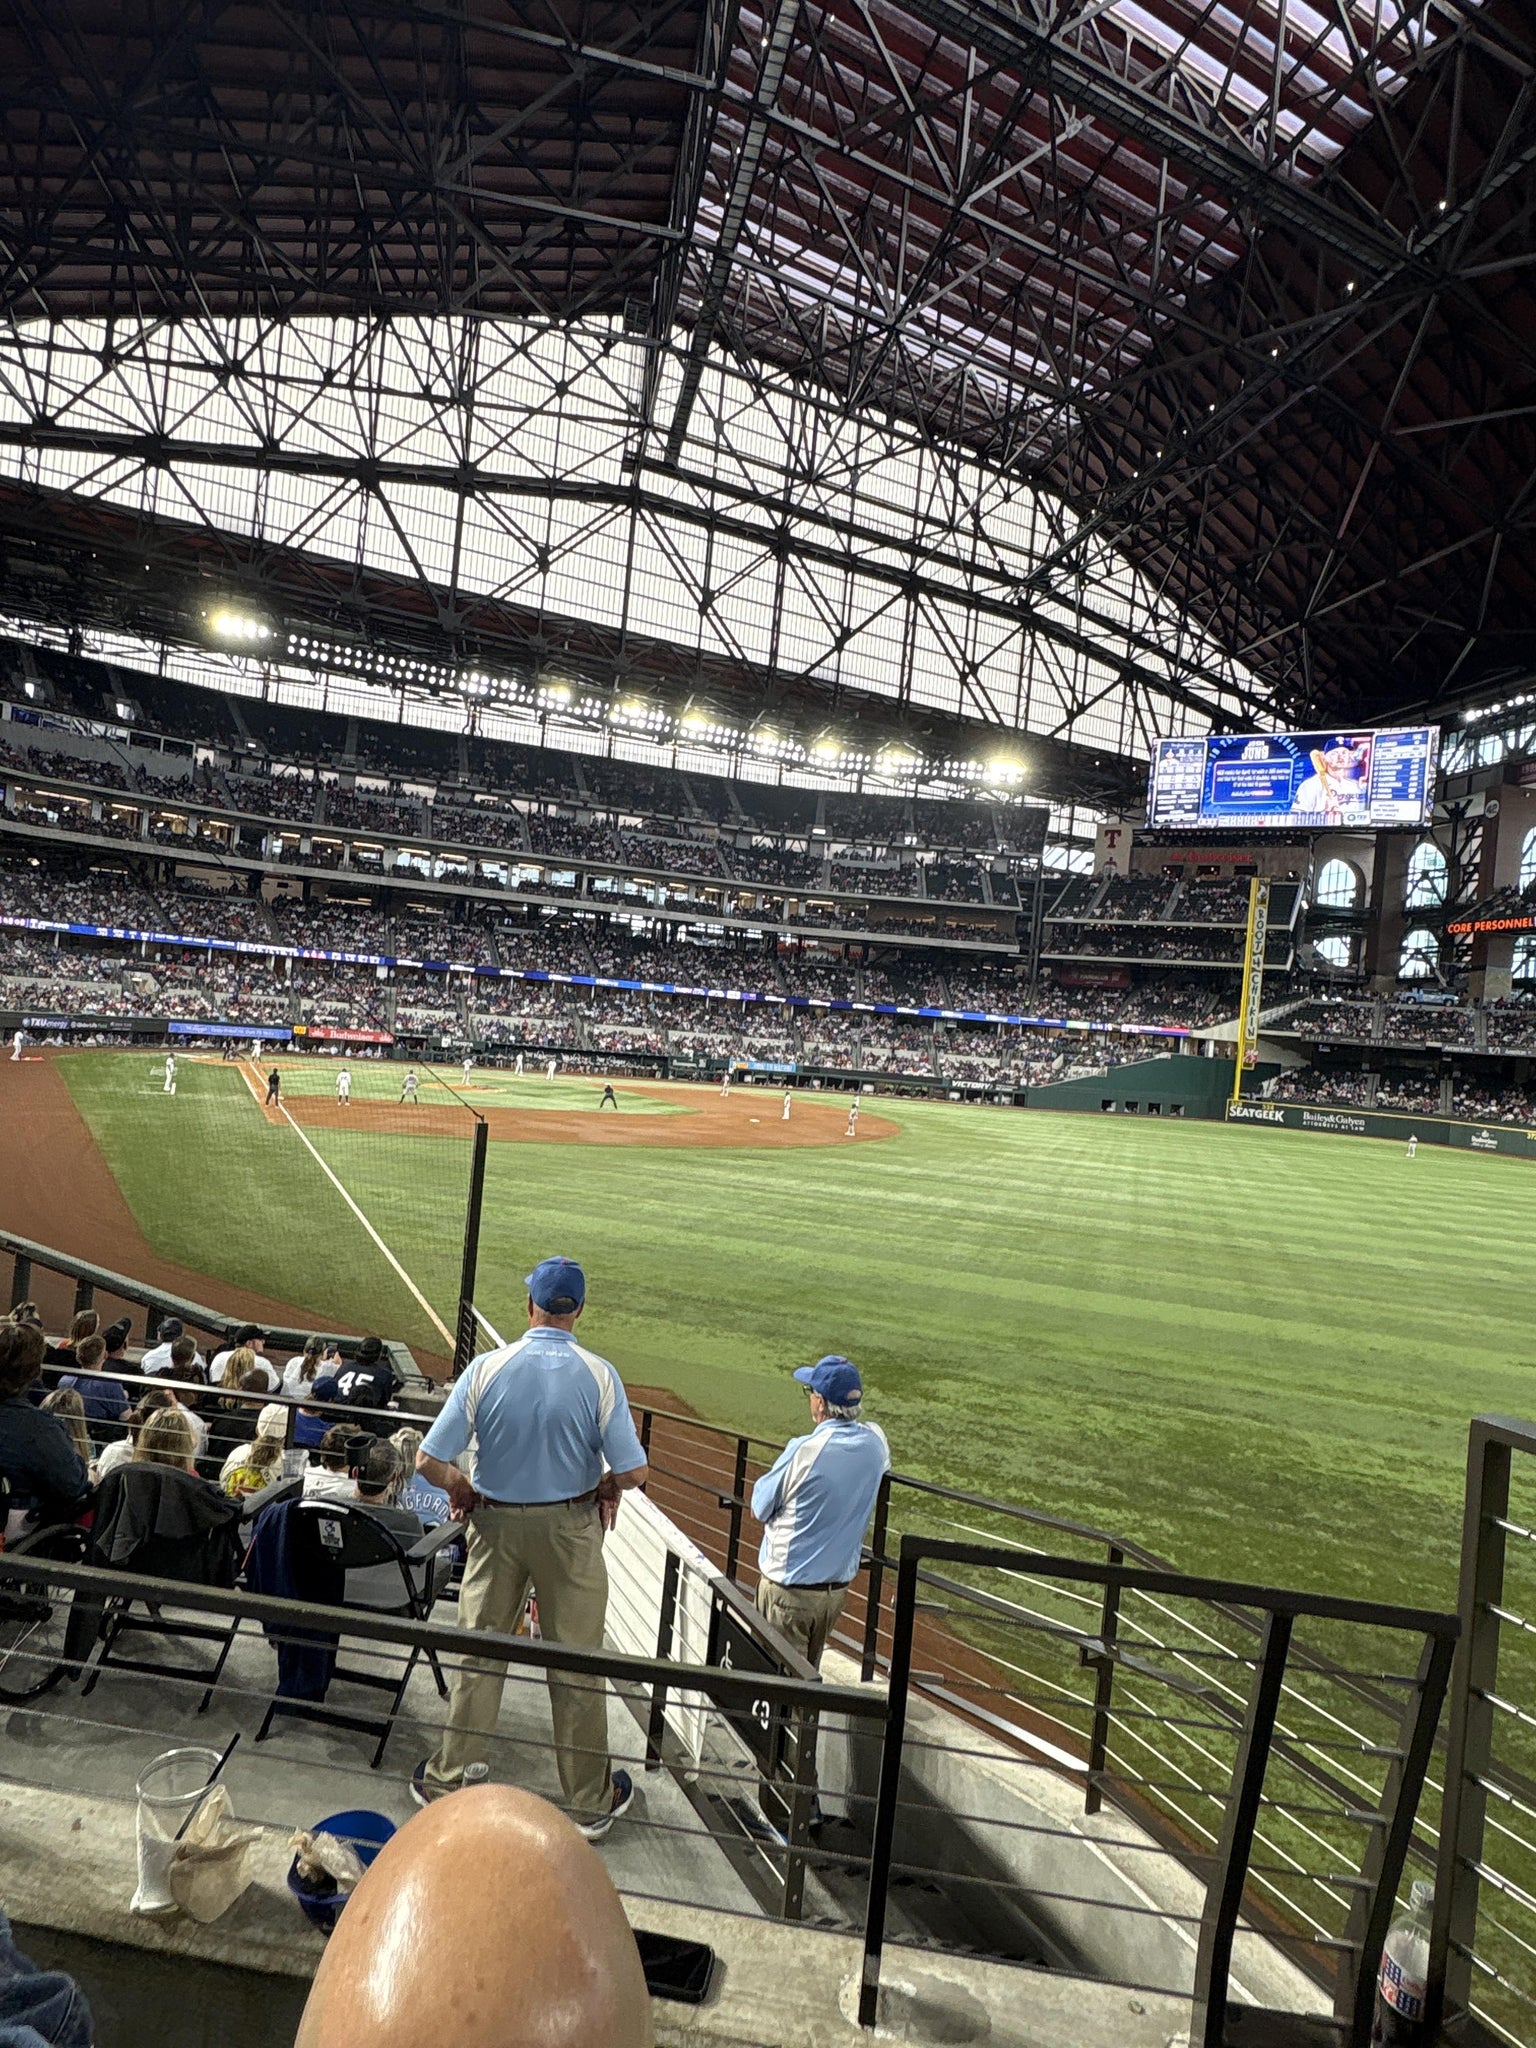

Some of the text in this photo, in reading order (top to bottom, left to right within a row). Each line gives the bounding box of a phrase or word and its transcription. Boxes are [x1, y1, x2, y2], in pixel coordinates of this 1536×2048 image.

[1104, 829, 1122, 849] T
[1447, 917, 1534, 934] CORE PERSONNEL
[330, 1030, 375, 1042] Budweiser
[952, 1080, 991, 1090] VICTORY
[1229, 1106, 1285, 1122] SEATGEEK
